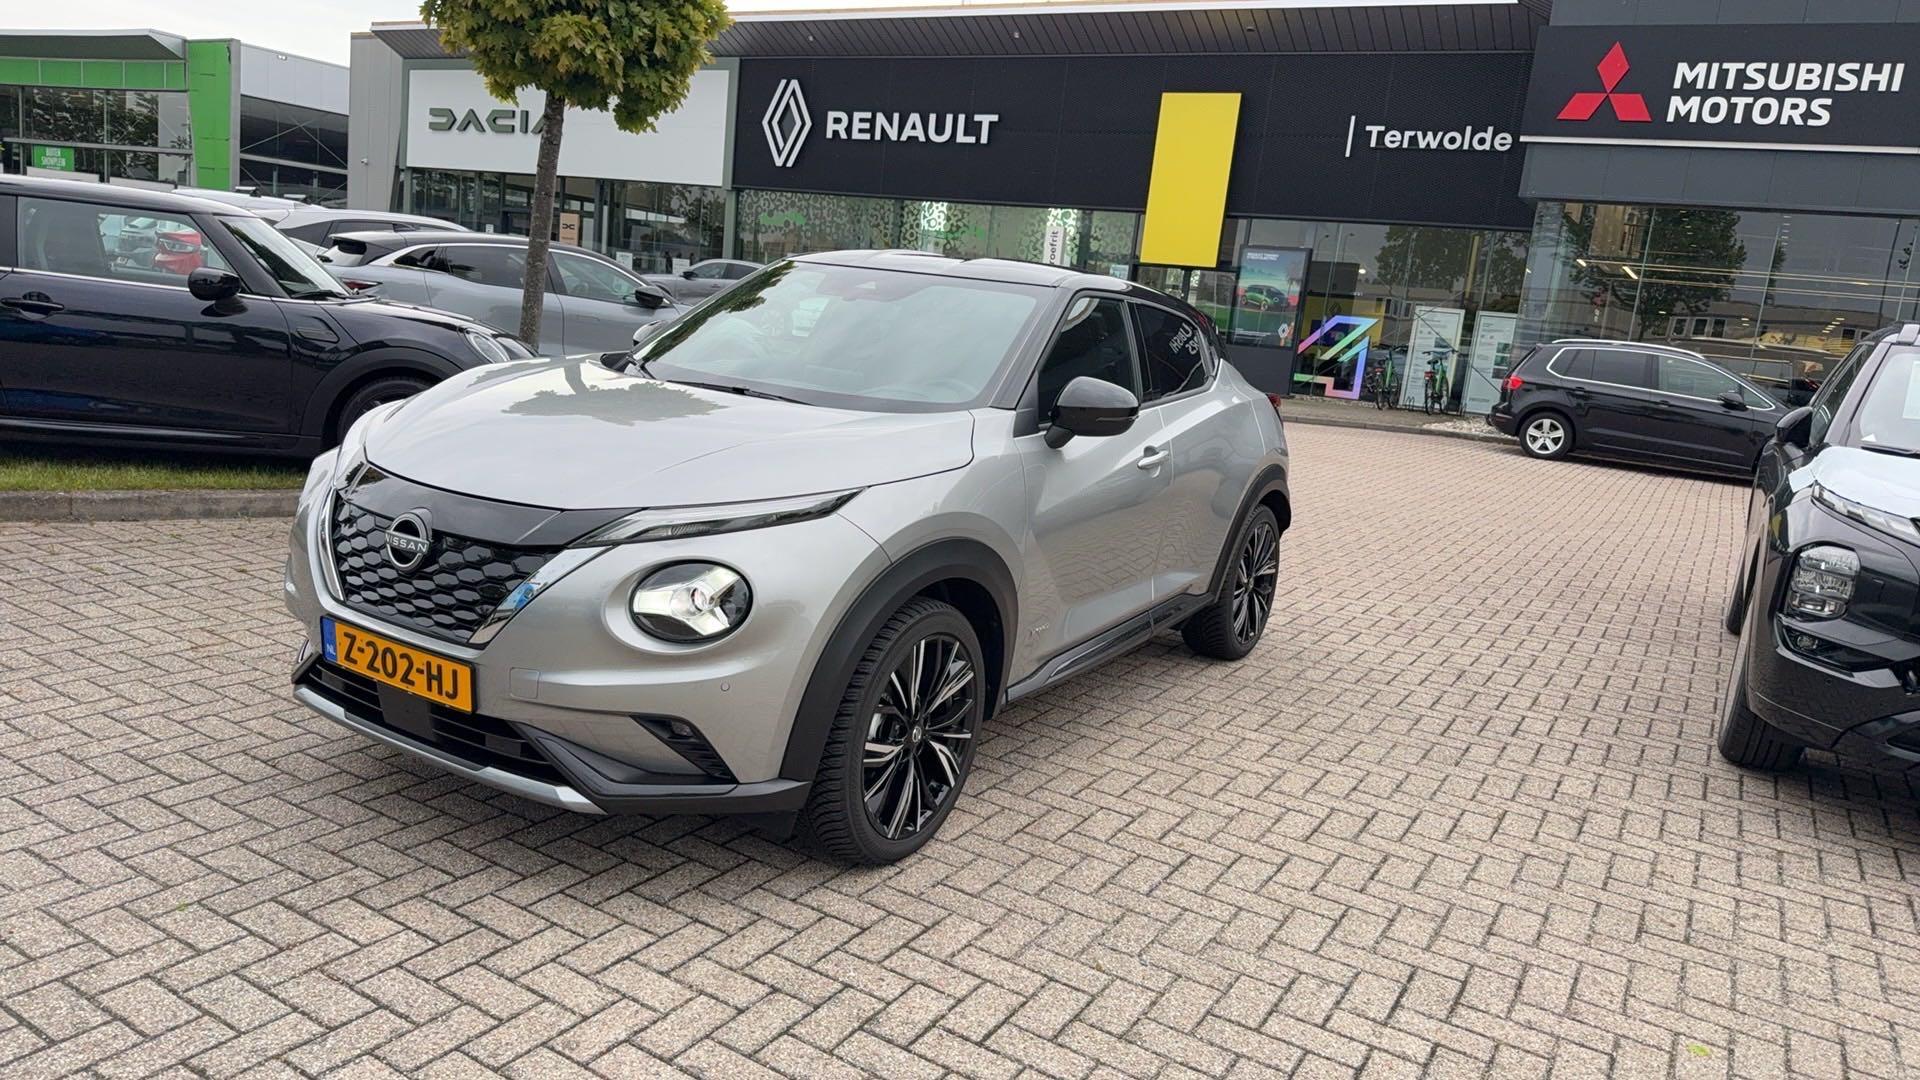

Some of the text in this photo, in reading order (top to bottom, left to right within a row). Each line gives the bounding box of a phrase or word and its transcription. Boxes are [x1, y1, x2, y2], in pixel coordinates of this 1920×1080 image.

[1673, 62, 1905, 92] MITSUBISHI
[1666, 96, 1833, 127] MOTORS
[825, 110, 999, 144] RENAULT
[1365, 125, 1513, 152] Terwolde
[385, 533, 427, 552] NISSAN
[343, 631, 458, 700] Z-202-HJ
